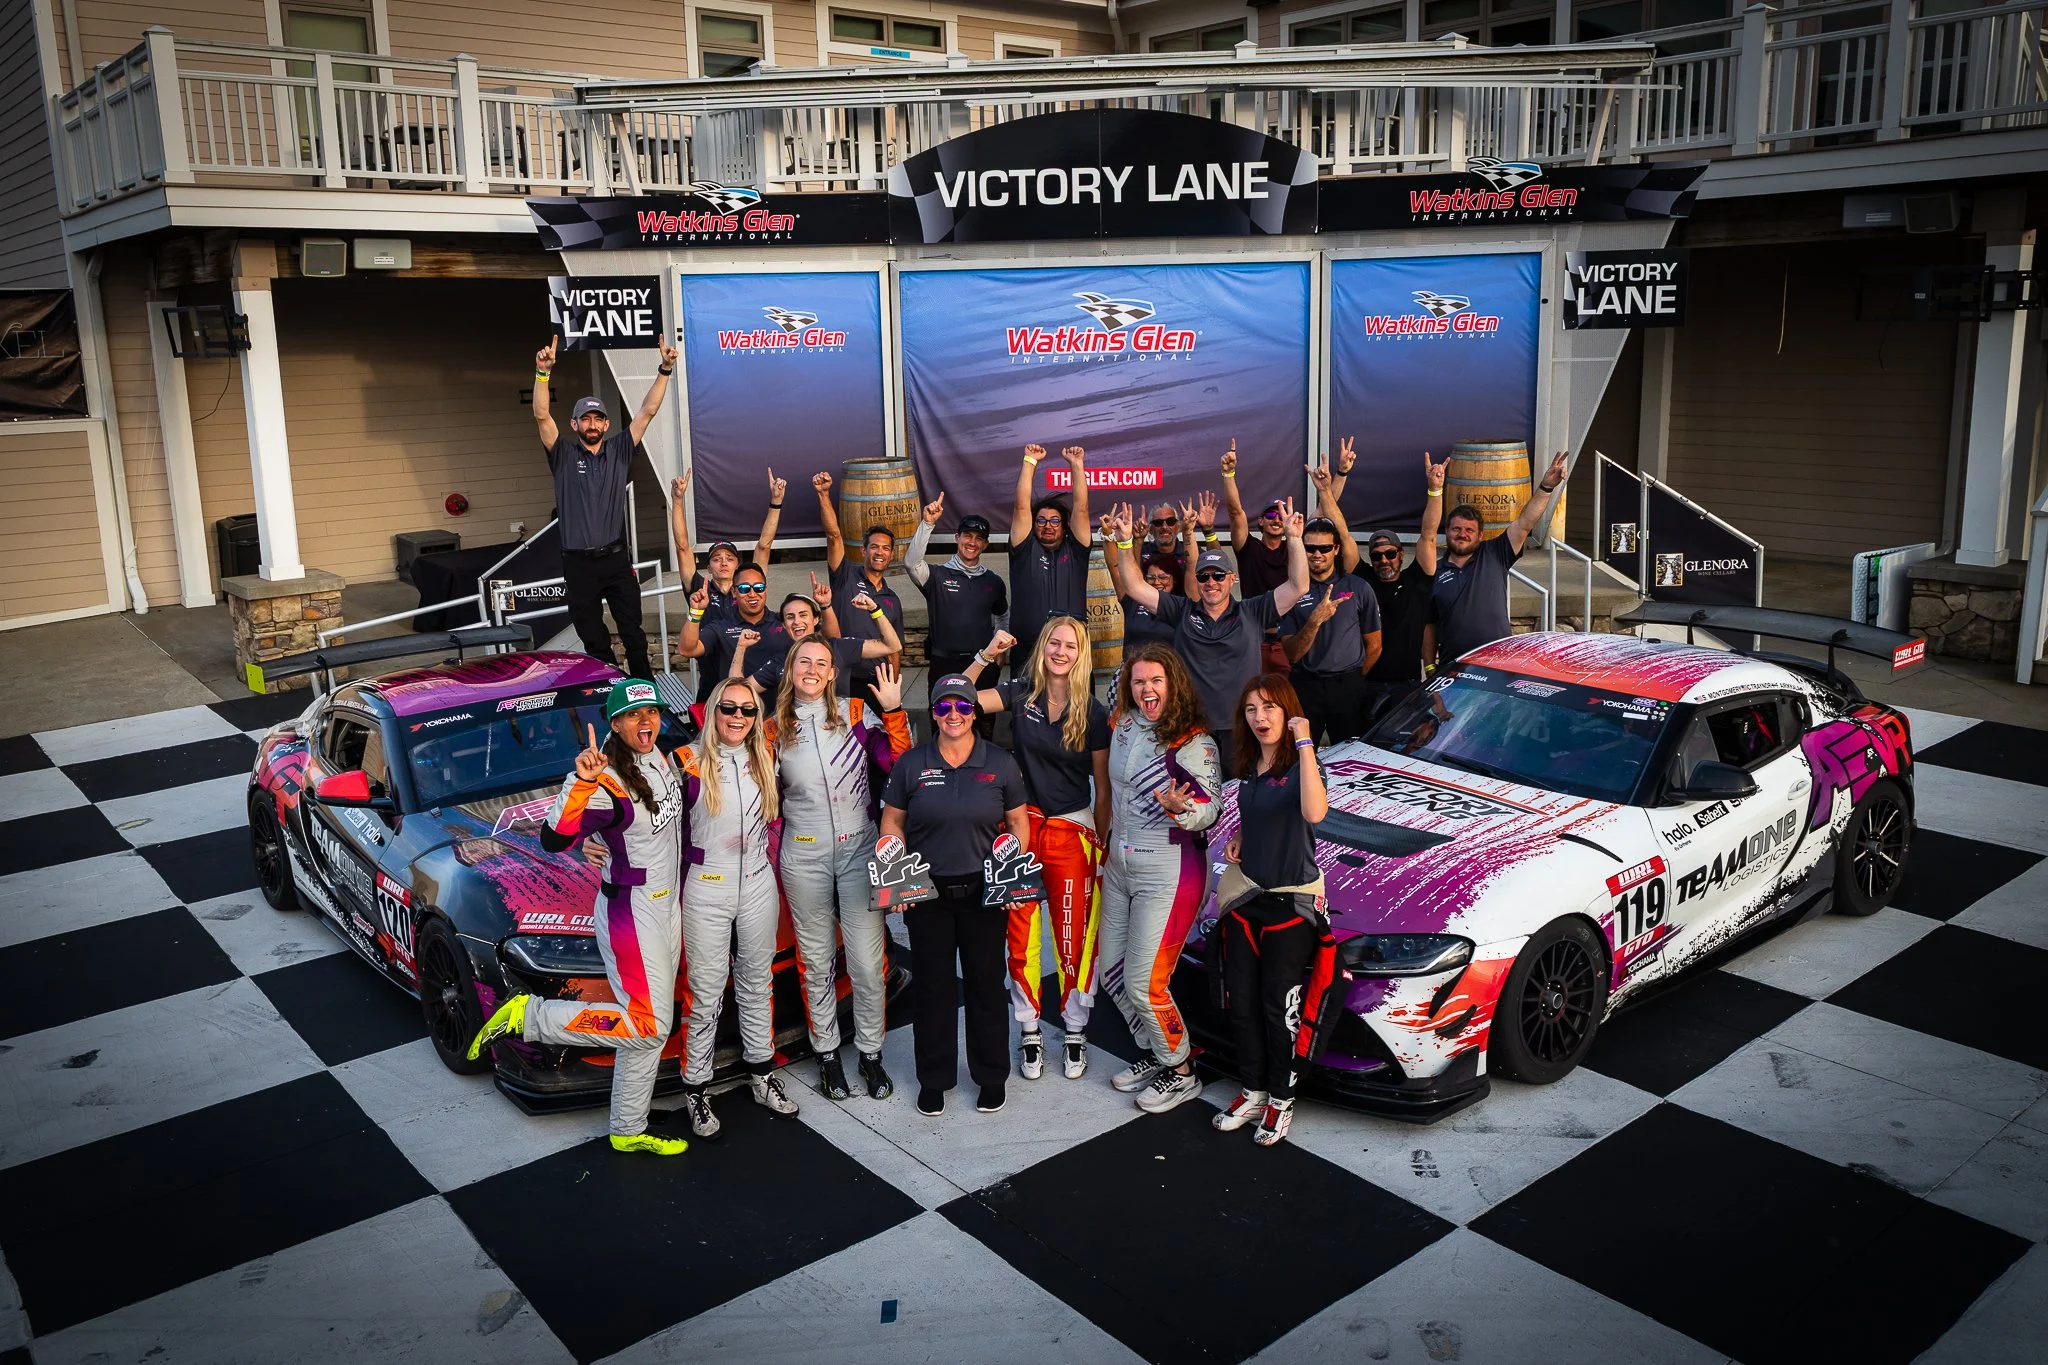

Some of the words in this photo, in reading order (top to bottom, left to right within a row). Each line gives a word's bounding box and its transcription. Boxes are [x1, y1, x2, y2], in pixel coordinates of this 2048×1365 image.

[934, 165, 1134, 208] VICTORY
[1147, 161, 1270, 203] LANE
[1409, 188, 1516, 213] Watkins
[1520, 184, 1578, 208] Glen
[637, 210, 739, 233] Watkins
[743, 209, 795, 231] Glen
[1412, 208, 1574, 222] INTERNATIONAL
[641, 232, 793, 242] INTERNATIONAL
[1577, 262, 1678, 283] VICTORY
[560, 288, 651, 307] VICTORY
[1577, 284, 1677, 315] LANE
[562, 309, 654, 338] LANE
[1364, 314, 1450, 336] Watkins
[1452, 312, 1500, 333] Glen
[717, 329, 801, 350] Watkins
[802, 327, 846, 347] Glen
[1006, 325, 1129, 355] Watkins
[1131, 323, 1197, 353] Glen
[1367, 332, 1496, 342] INTERNATIONAL
[722, 346, 844, 356] INTERNATIONAL
[1011, 353, 1192, 364] INTERNATIONAL
[1051, 470, 1157, 487] THGLEN.COM
[868, 503, 918, 517] GLENORA
[1457, 494, 1516, 505] GLENORA
[1684, 558, 1749, 572] GLENORA
[1425, 676, 1455, 692] 119
[1456, 672, 1488, 682] YOKOHAMA
[1707, 686, 1742, 699] MONTGOMERY
[1602, 700, 1652, 714] YOKOHAMA
[424, 713, 473, 728] YOKOHAMA
[1335, 780, 1479, 820] RACING
[1360, 771, 1516, 816] VICTORY
[361, 819, 382, 845] halo.
[1661, 822, 1697, 845] halo.
[1696, 803, 1727, 827] Sabelt
[1617, 860, 1656, 887] WRL
[1722, 844, 1790, 892] LOGISTICS
[382, 876, 406, 900] WRL
[378, 891, 412, 954] 120
[522, 913, 566, 924] WRL
[1614, 877, 1666, 946] 119
[1062, 879, 1076, 978] PORSCHE
[1701, 933, 1729, 953] VOGEL
[1729, 903, 1775, 938] PROPERTIES
[394, 940, 411, 963] GTO
[1623, 930, 1655, 957] GTO
[1627, 952, 1657, 974] YOKOHAMA
